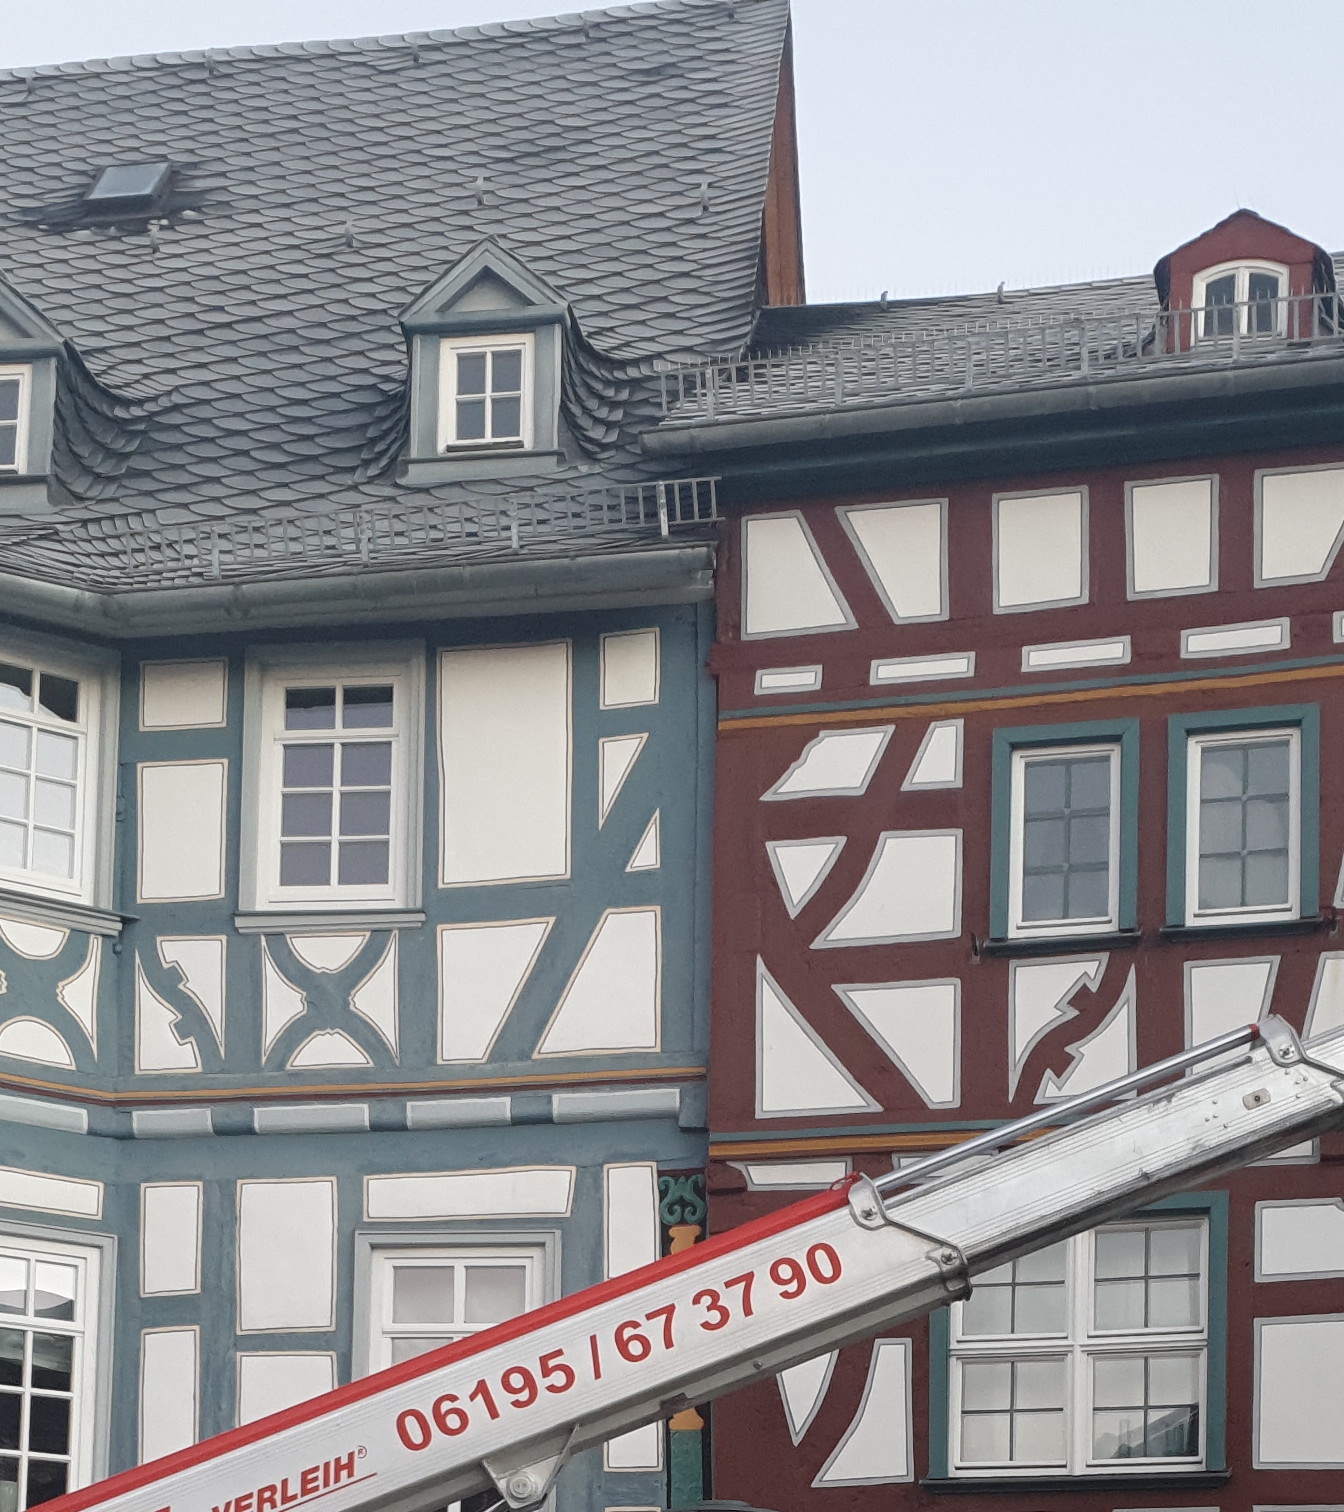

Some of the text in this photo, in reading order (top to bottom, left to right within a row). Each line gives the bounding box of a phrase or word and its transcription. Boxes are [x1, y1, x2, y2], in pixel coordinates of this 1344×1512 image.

[396, 1348, 576, 1451] 06195
[614, 1303, 677, 1363] 67
[691, 1271, 756, 1331] 37
[769, 1242, 843, 1300] 90
